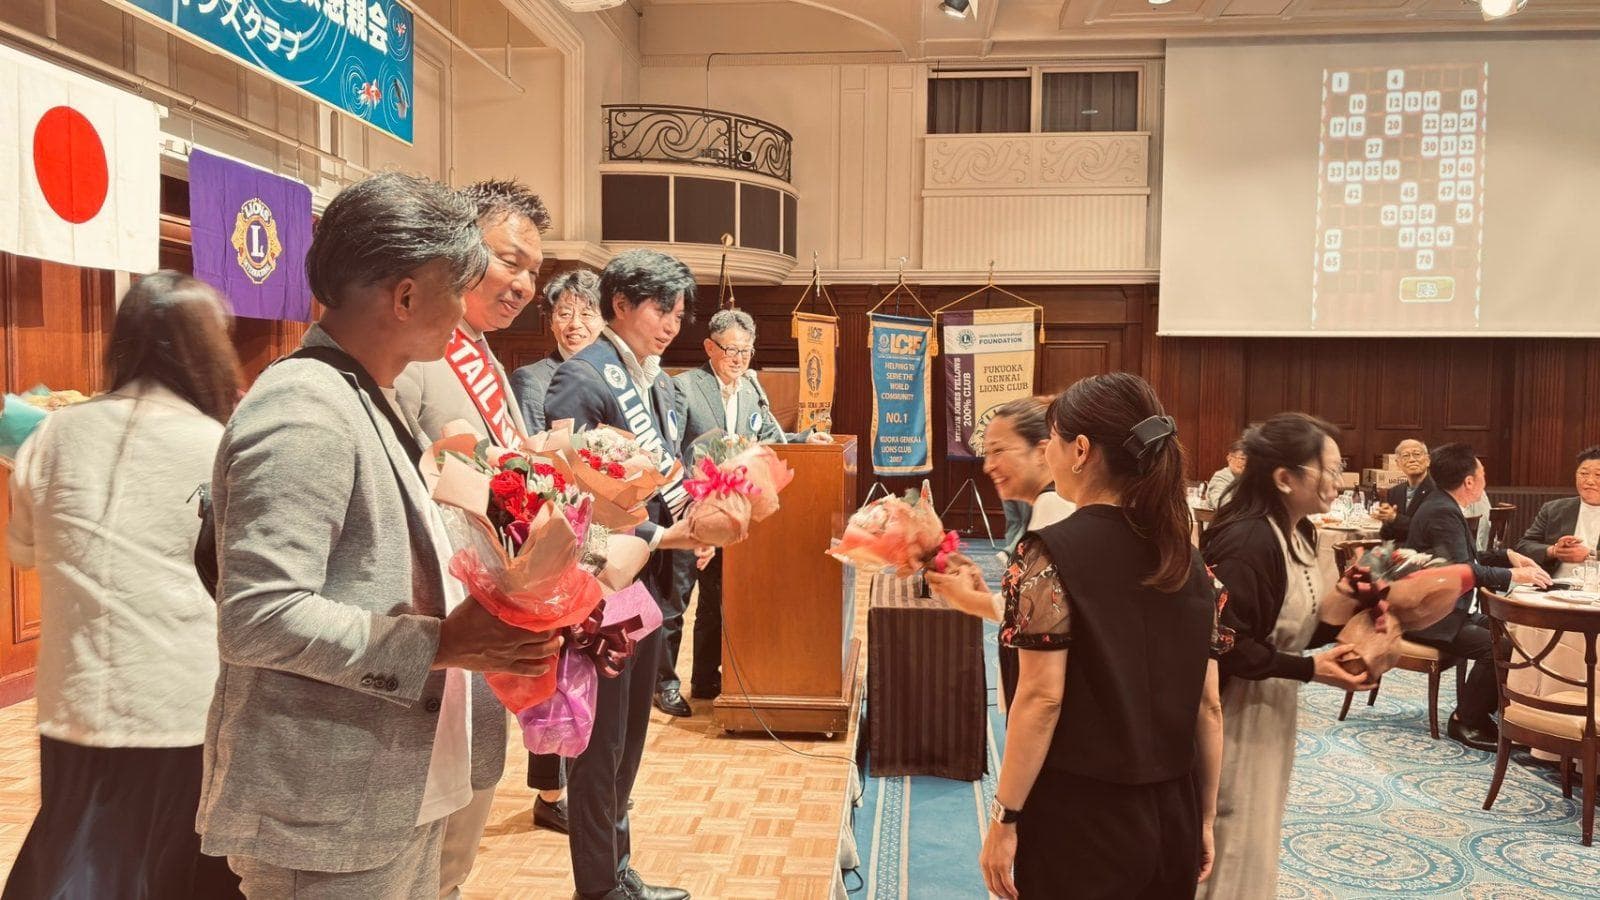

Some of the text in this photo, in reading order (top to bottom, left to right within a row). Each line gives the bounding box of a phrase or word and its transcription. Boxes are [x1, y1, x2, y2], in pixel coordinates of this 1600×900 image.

[1352, 95, 1474, 109] 10 12 13 14 16
[1333, 118, 1474, 132] 17 18 20 22 23 24
[1368, 140, 1473, 153] 27 30 31 32
[1330, 167, 1342, 177] 33
[1348, 166, 1361, 176] 34
[1367, 166, 1379, 175] 35
[1385, 165, 1397, 175] 36
[1442, 163, 1453, 173] 39
[1440, 187, 1452, 196] 47
[1383, 211, 1396, 220] 52
[1421, 209, 1433, 218] 54
[1458, 208, 1470, 218] 56
[250, 225, 265, 257] L
[1419, 255, 1431, 265] 70
[979, 337, 1023, 345] FOUNDATION
[983, 364, 1023, 374] FUKUOKA
[450, 339, 499, 413] TAIL
[987, 373, 1021, 383] GENKAI
[979, 382, 1029, 393] LIONS CLUB
[963, 372, 971, 427] 200% CLUB
